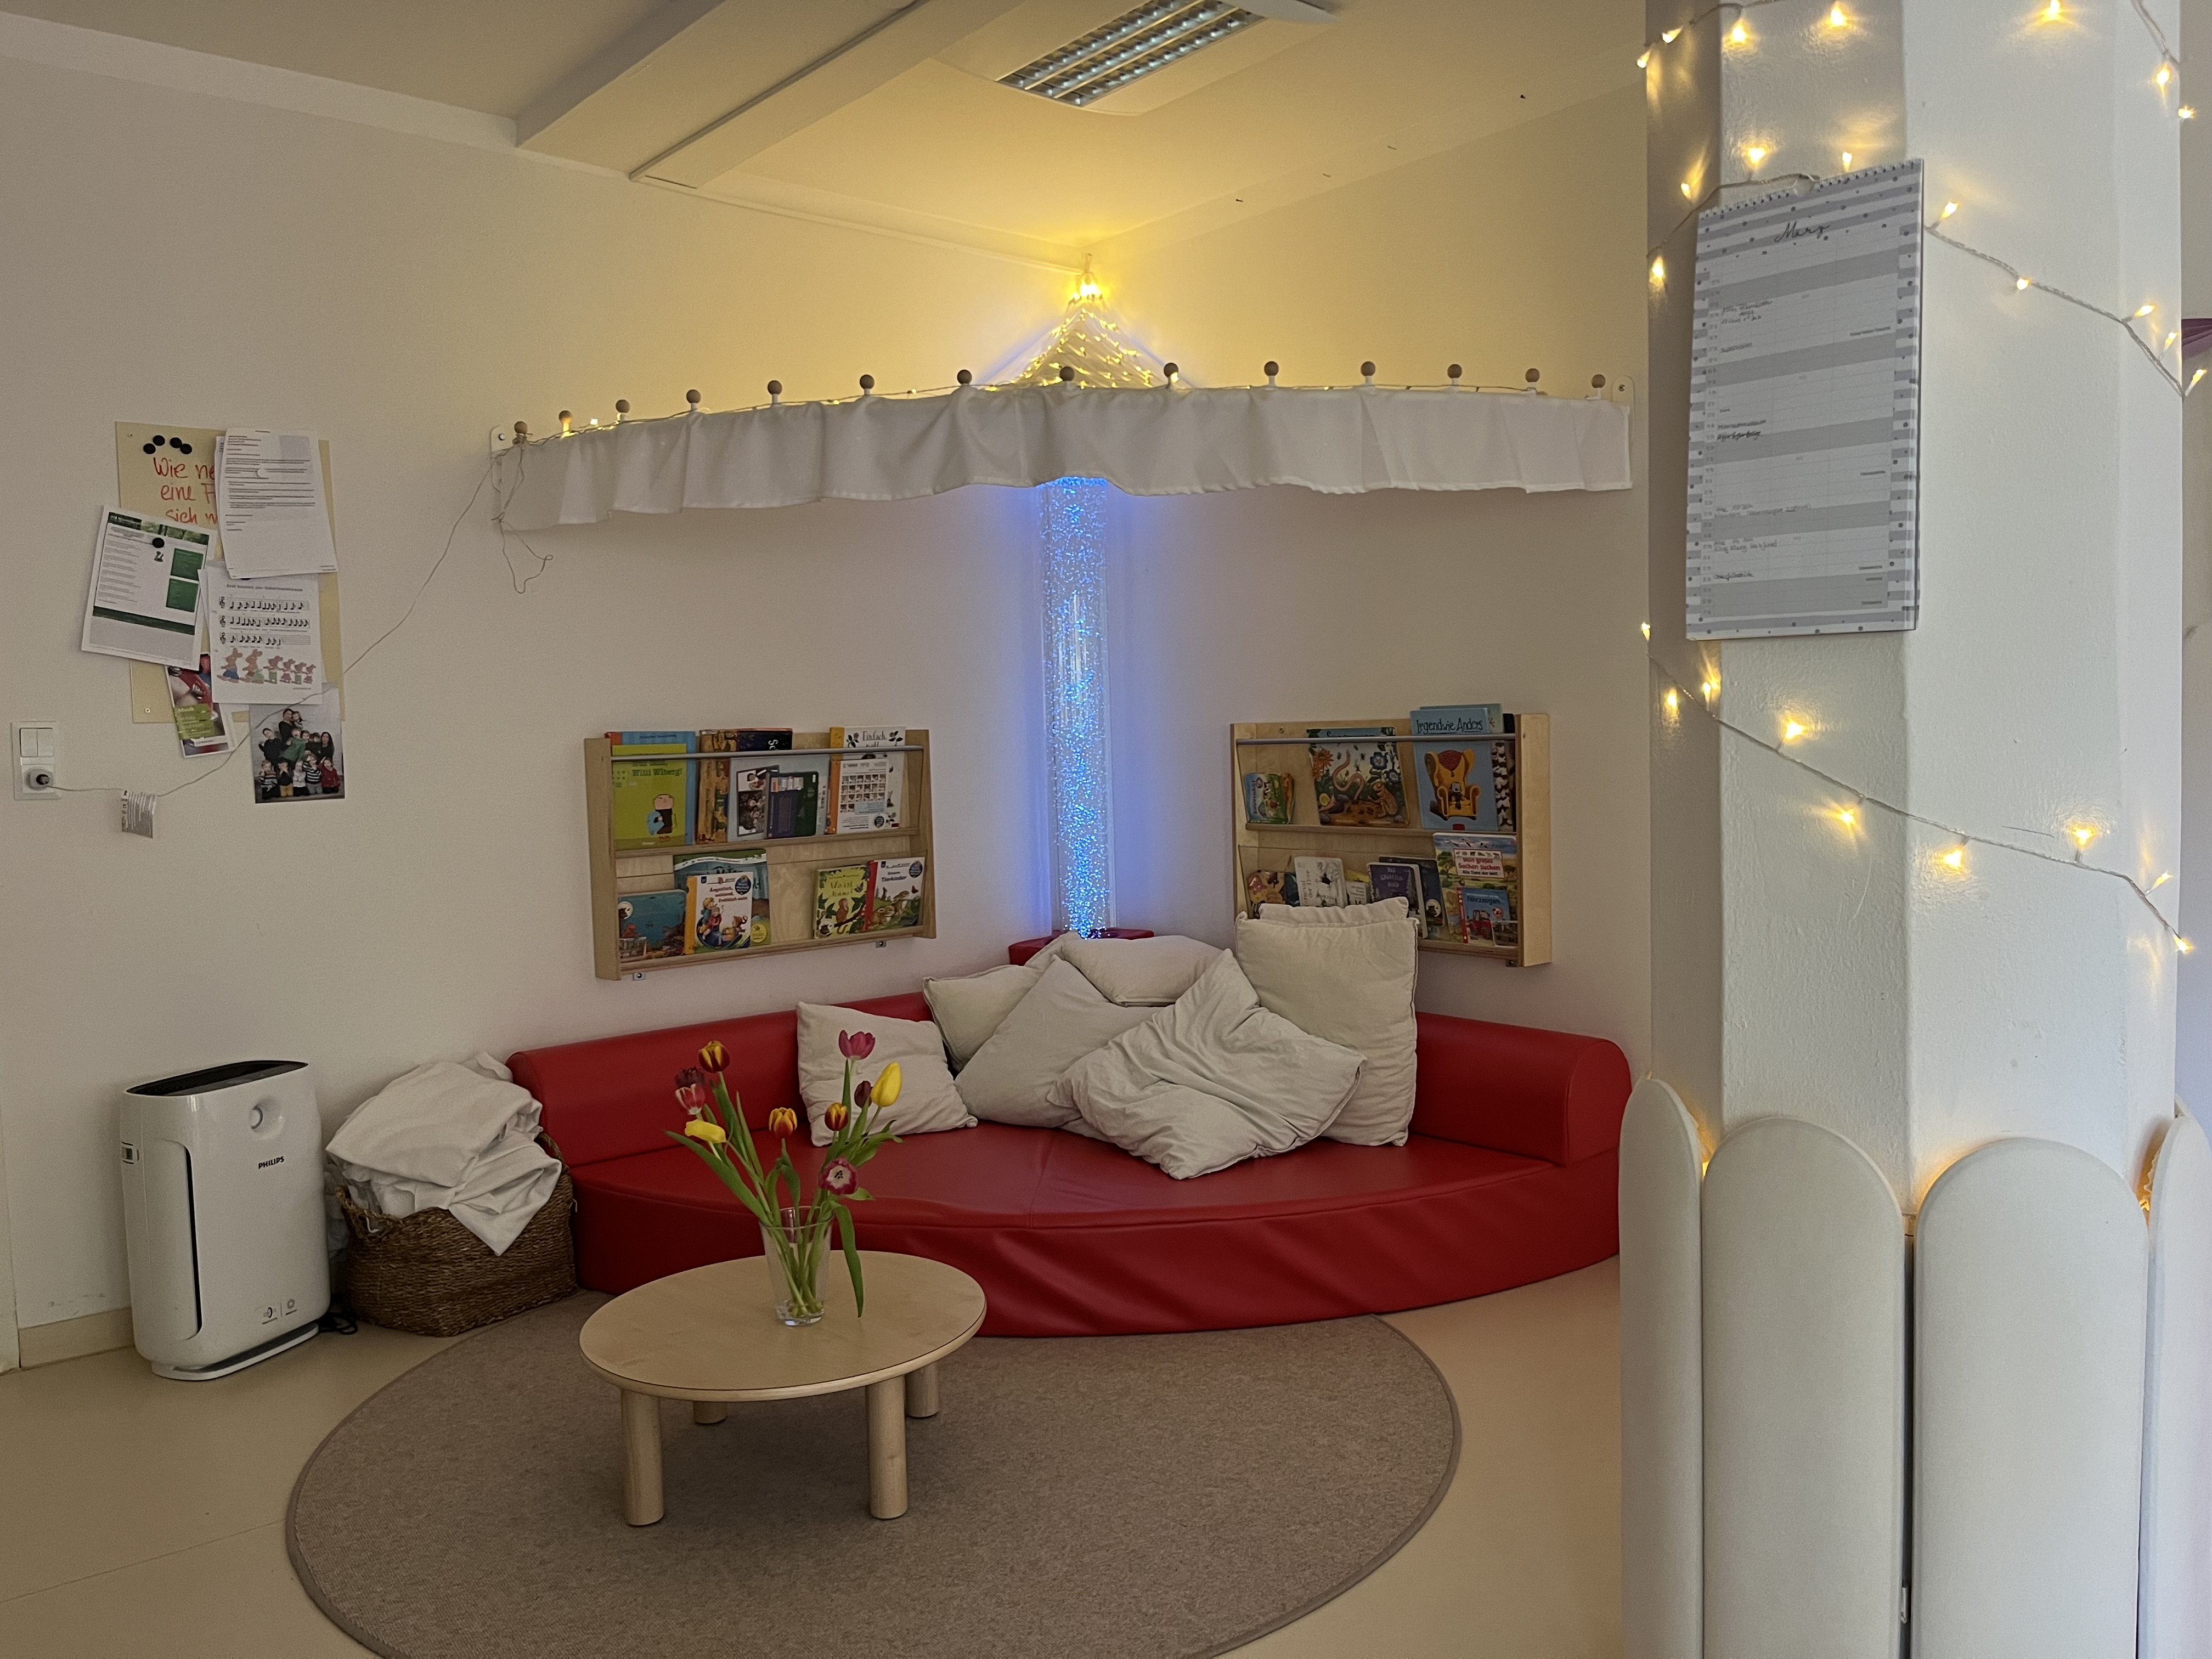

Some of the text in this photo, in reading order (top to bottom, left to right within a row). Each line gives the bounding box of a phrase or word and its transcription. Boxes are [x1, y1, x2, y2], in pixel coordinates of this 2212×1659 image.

[154, 457, 188, 478] Wie
[161, 482, 196, 501] eine
[166, 507, 197, 524] sich
[1417, 718, 1483, 735] Irgendwie Anders
[258, 1156, 284, 1169] PHILIPS
